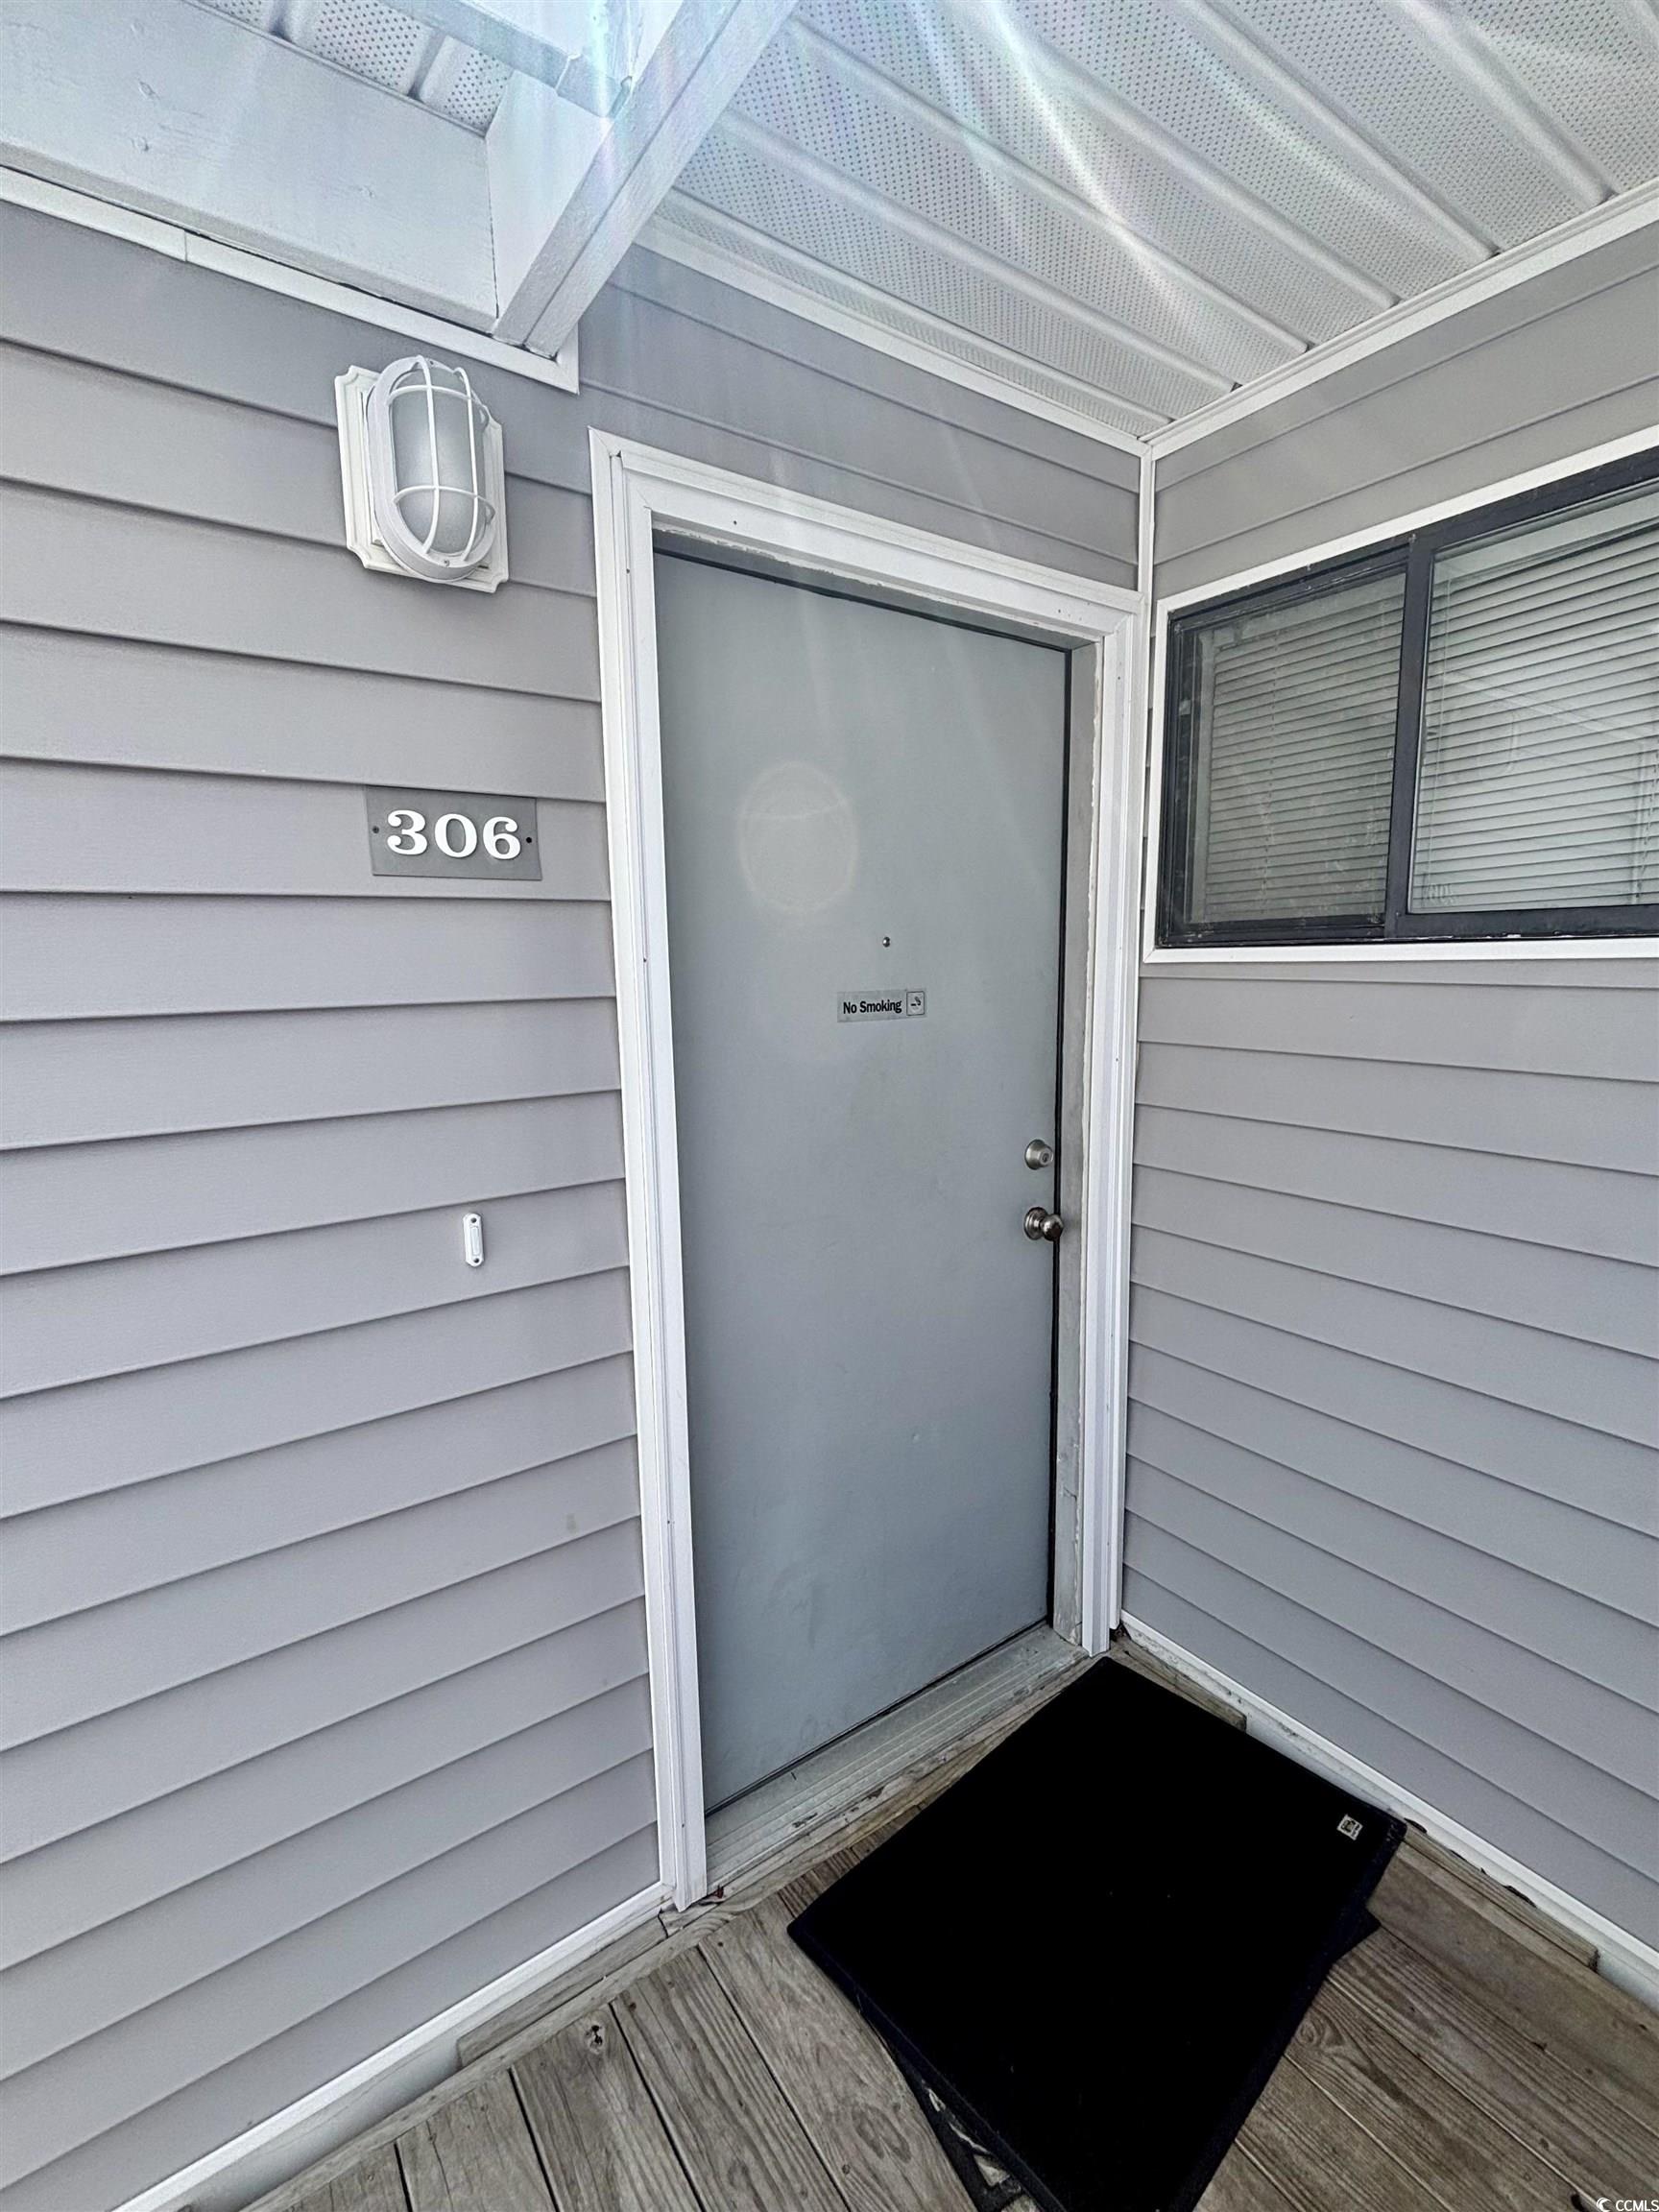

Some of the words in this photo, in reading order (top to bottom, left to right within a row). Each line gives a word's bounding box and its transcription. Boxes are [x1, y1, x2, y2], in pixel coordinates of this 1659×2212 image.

[387, 809, 521, 860] 306
[843, 1001, 857, 1015] No
[859, 999, 902, 1014] Smoking
